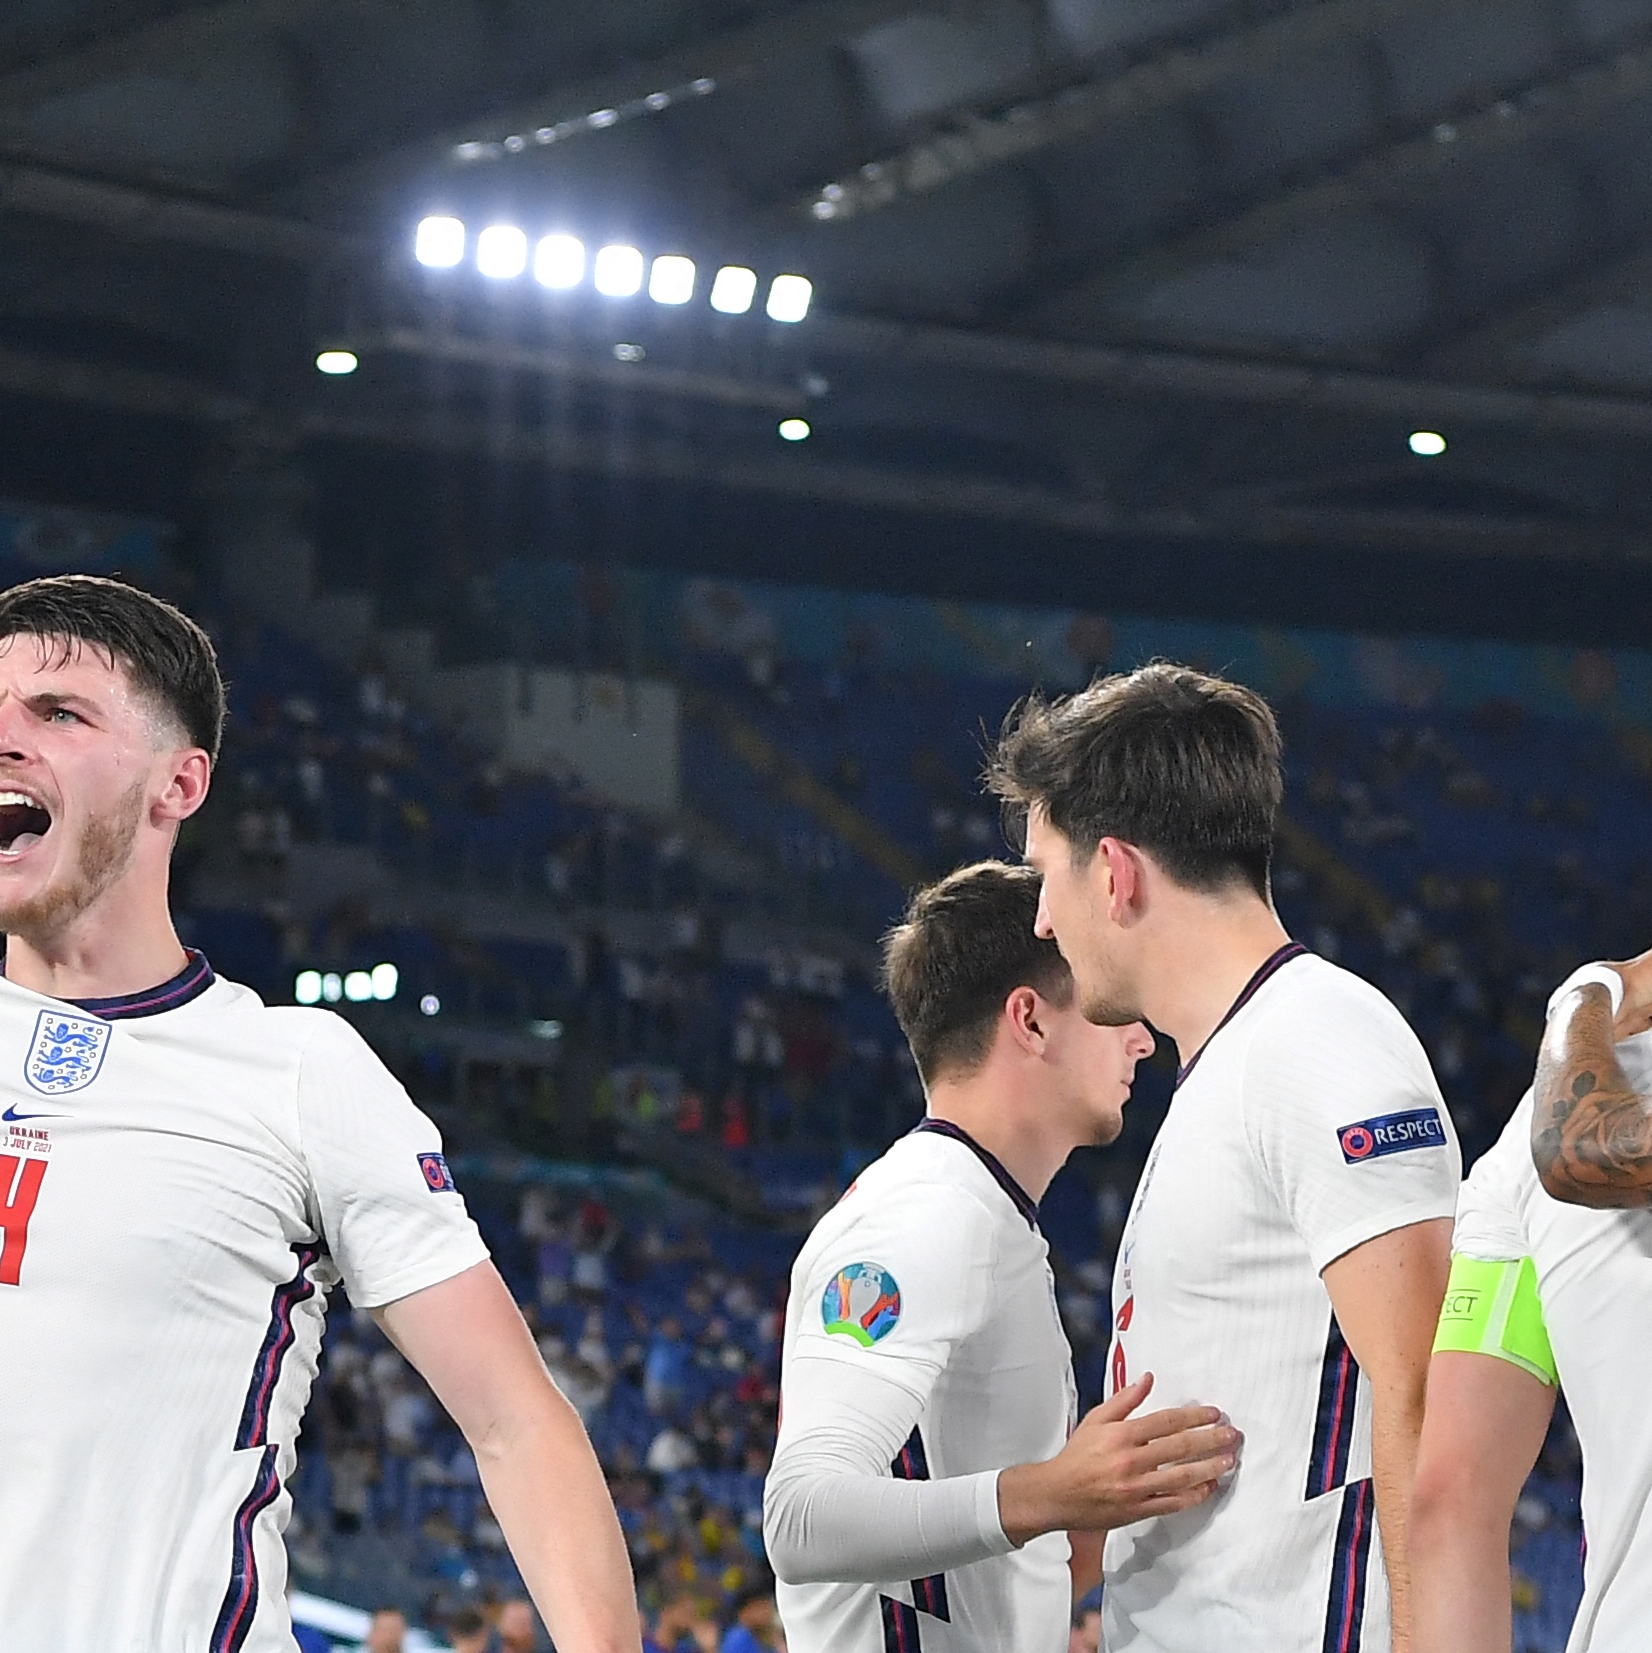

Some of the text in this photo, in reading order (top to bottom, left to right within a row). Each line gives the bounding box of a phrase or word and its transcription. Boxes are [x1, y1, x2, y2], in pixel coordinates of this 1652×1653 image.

[9, 1125, 49, 1141] UKRAINE
[1374, 1118, 1441, 1145] RESPECT
[10, 1138, 32, 1150] JULY
